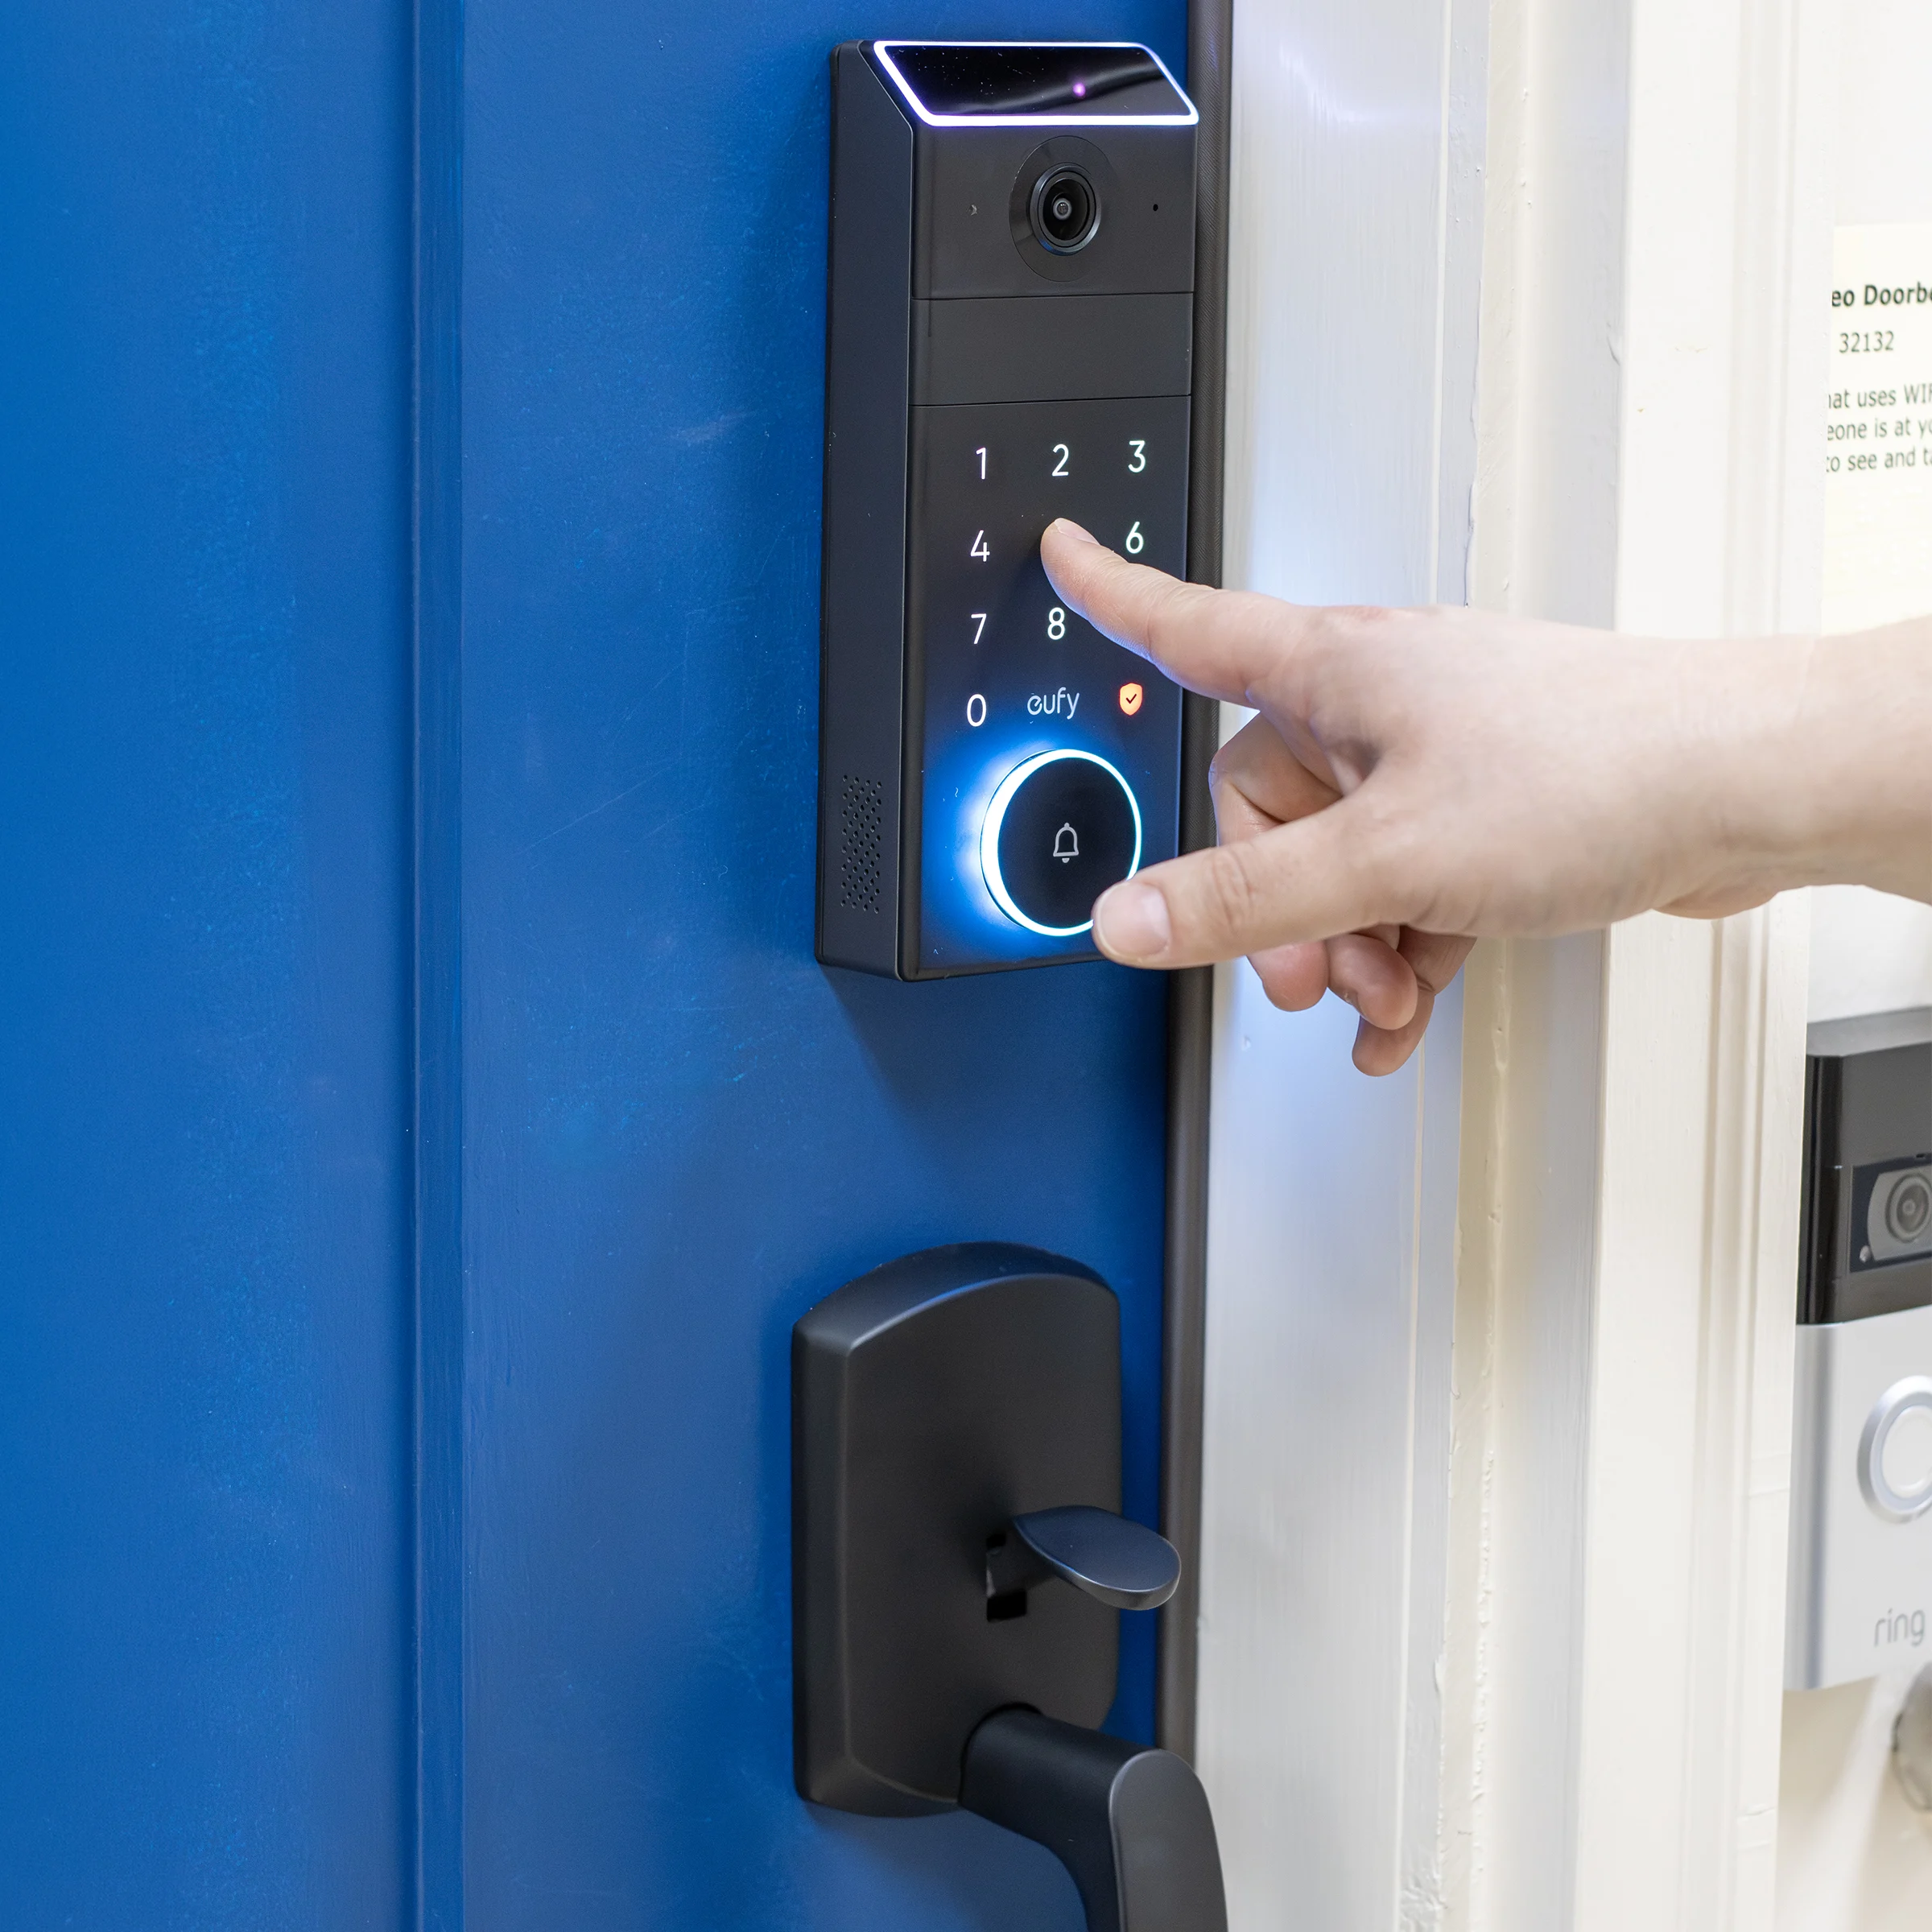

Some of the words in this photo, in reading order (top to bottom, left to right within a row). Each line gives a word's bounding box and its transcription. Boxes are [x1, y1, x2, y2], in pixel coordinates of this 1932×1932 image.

[1864, 281, 1932, 305] Doorb
[1839, 331, 1893, 353] 32132
[1858, 390, 1897, 407] uses
[1875, 418, 1887, 438] is
[1894, 418, 1910, 436] at
[976, 447, 986, 480] 1
[1051, 444, 1069, 477] 2
[1128, 440, 1146, 473] 3
[1847, 454, 1877, 471] see
[1885, 446, 1916, 469] and
[970, 530, 990, 562] 4
[1125, 521, 1144, 554] 6
[971, 613, 987, 645] 7
[1047, 607, 1066, 640] 8
[966, 693, 987, 727] 0
[1026, 687, 1080, 720] eufy
[1873, 1608, 1926, 1648] ring
